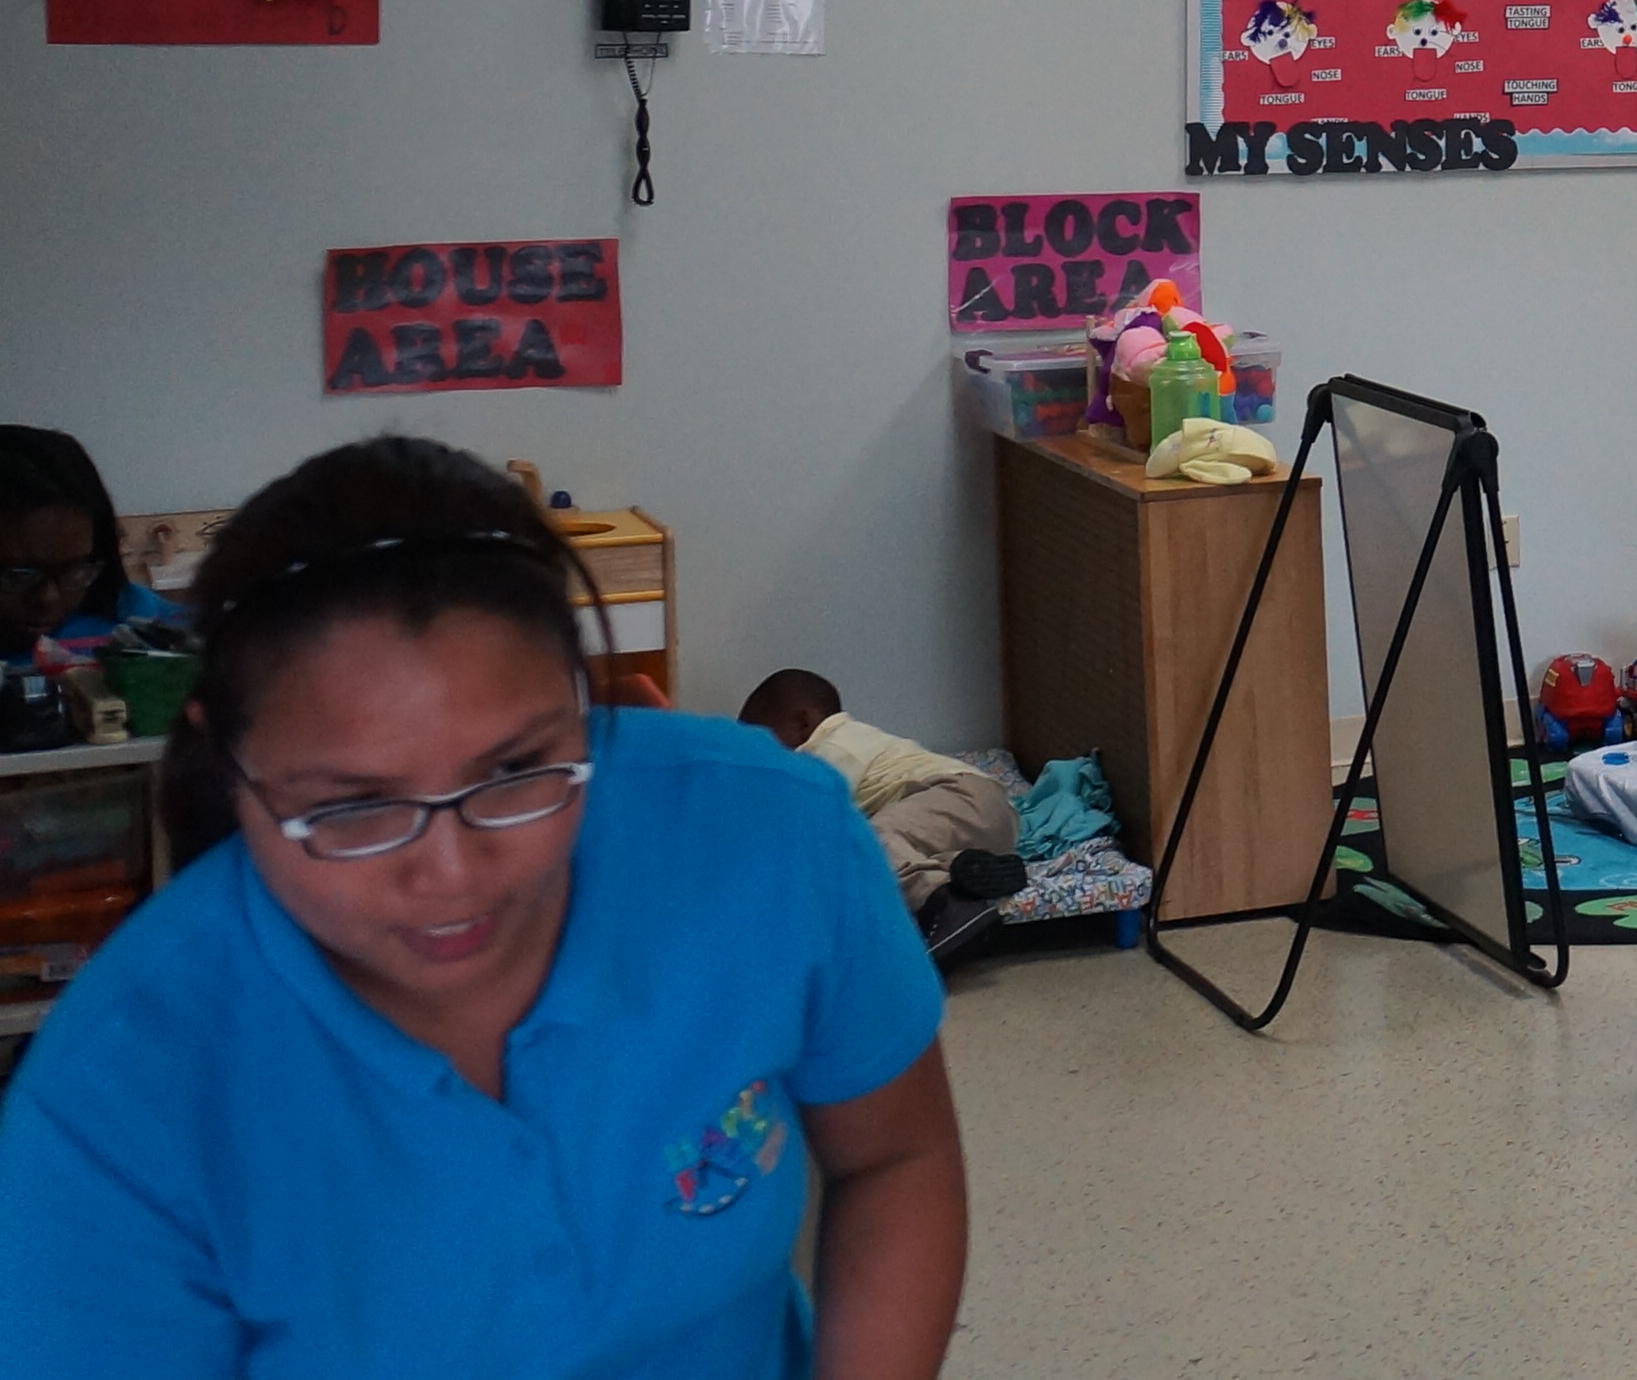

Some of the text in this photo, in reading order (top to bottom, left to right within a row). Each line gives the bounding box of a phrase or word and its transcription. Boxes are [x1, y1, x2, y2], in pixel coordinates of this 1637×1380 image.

[1507, 7, 1548, 17] TASTING
[1508, 18, 1549, 28] TONGUE
[1456, 62, 1481, 71] NOSE
[1312, 70, 1340, 80] NOSE
[1506, 81, 1555, 91] TOUCHING
[1261, 94, 1304, 104] TONGUE
[1407, 90, 1445, 100] TONGUE
[1513, 94, 1547, 104] HANDS
[1185, 119, 1518, 175] MY SENSES
[953, 198, 1193, 260] BLOCK
[333, 242, 608, 313] HOUSE
[330, 318, 567, 390] AREA
